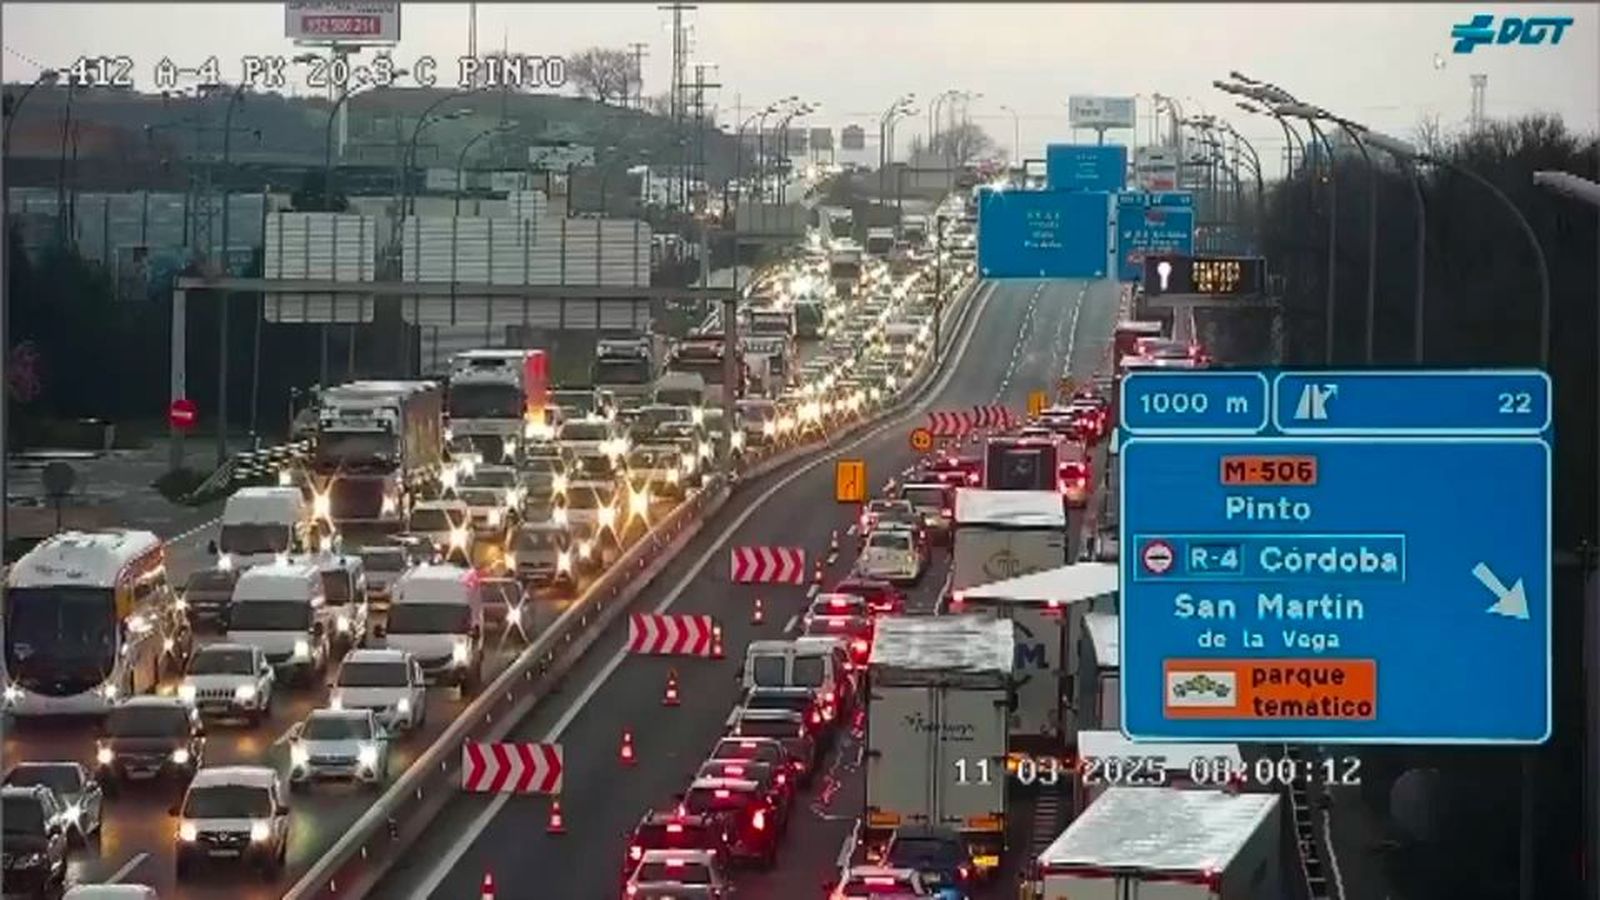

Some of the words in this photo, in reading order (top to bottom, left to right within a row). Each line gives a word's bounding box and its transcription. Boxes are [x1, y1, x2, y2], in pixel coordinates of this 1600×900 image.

[1140, 393, 1208, 413] 1000
[1226, 396, 1248, 413] m
[1498, 393, 1532, 413] 22
[1224, 461, 1313, 482] M-506
[1226, 496, 1312, 520] Pinto
[1191, 547, 1239, 569] R-4
[1259, 546, 1398, 573] Córdoba
[1174, 593, 1236, 619] San
[1257, 592, 1364, 619] Martín
[1197, 629, 1227, 648] de
[1243, 629, 1264, 648] la
[1282, 630, 1340, 653] Vega
[1252, 666, 1346, 688] parque
